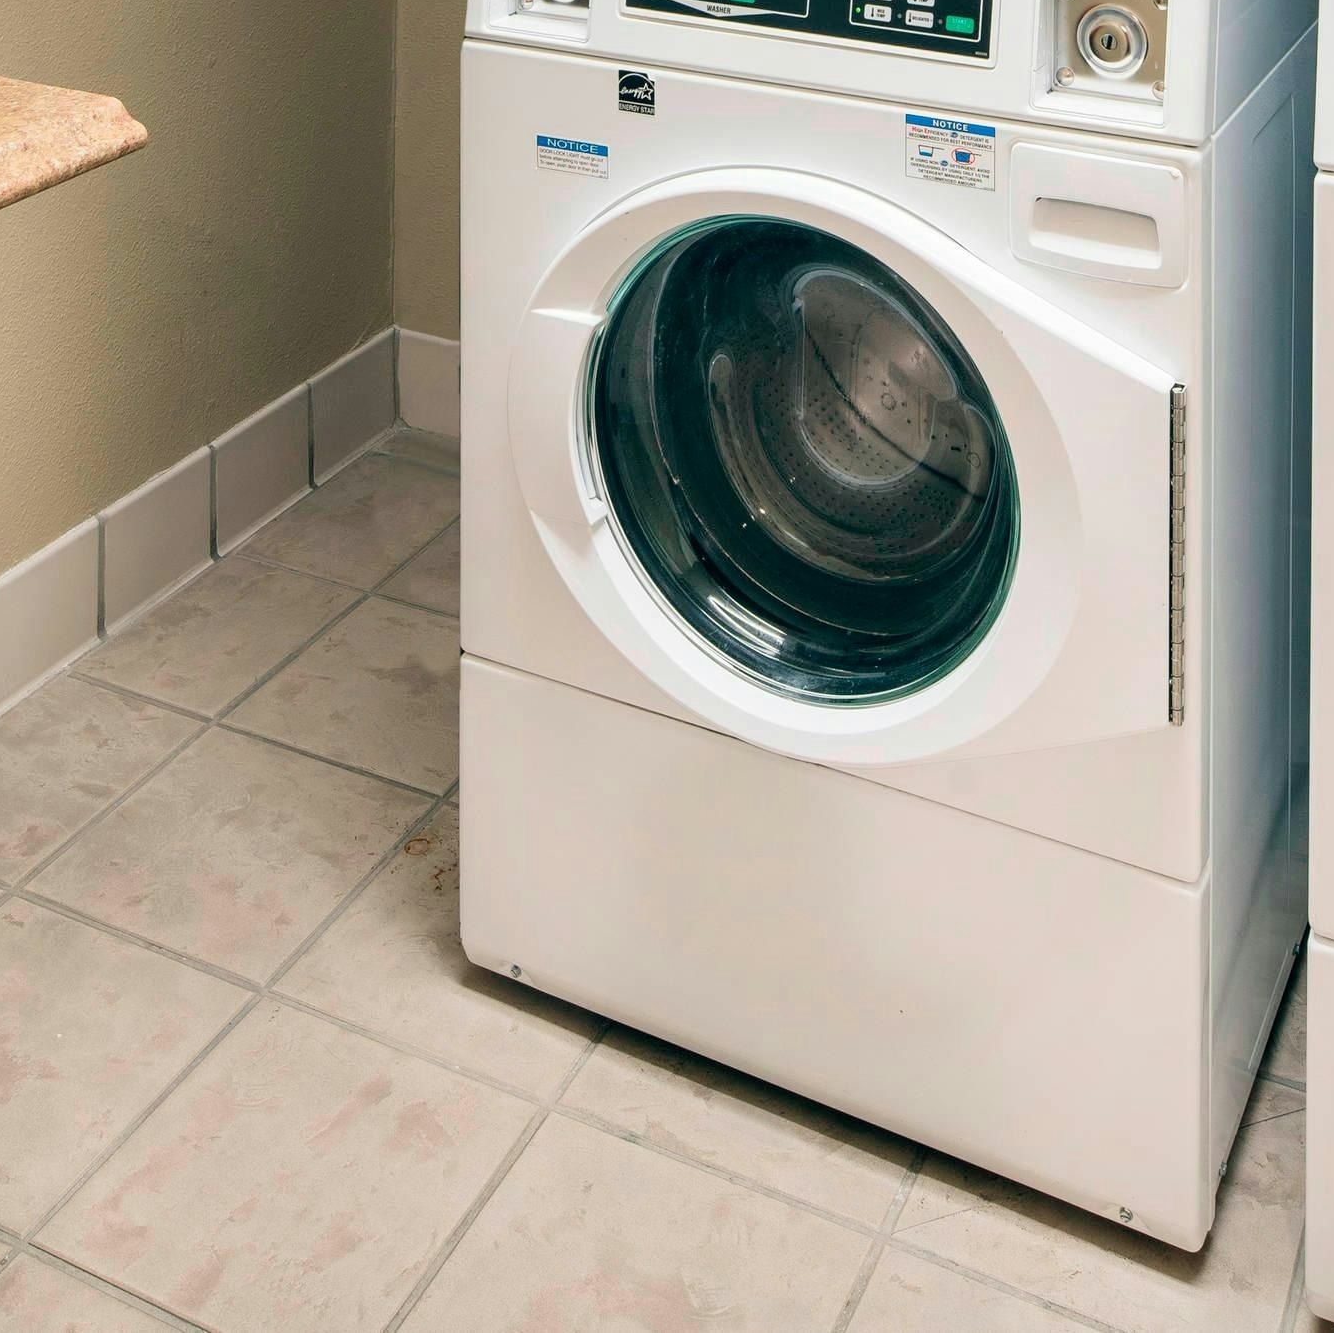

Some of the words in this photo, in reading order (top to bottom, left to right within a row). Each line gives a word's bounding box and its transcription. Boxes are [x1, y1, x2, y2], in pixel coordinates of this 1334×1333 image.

[707, 5, 731, 14] WASHER
[619, 103, 640, 113] ENERGY
[933, 120, 968, 132] NOTICE
[547, 138, 599, 154] NOTICE
